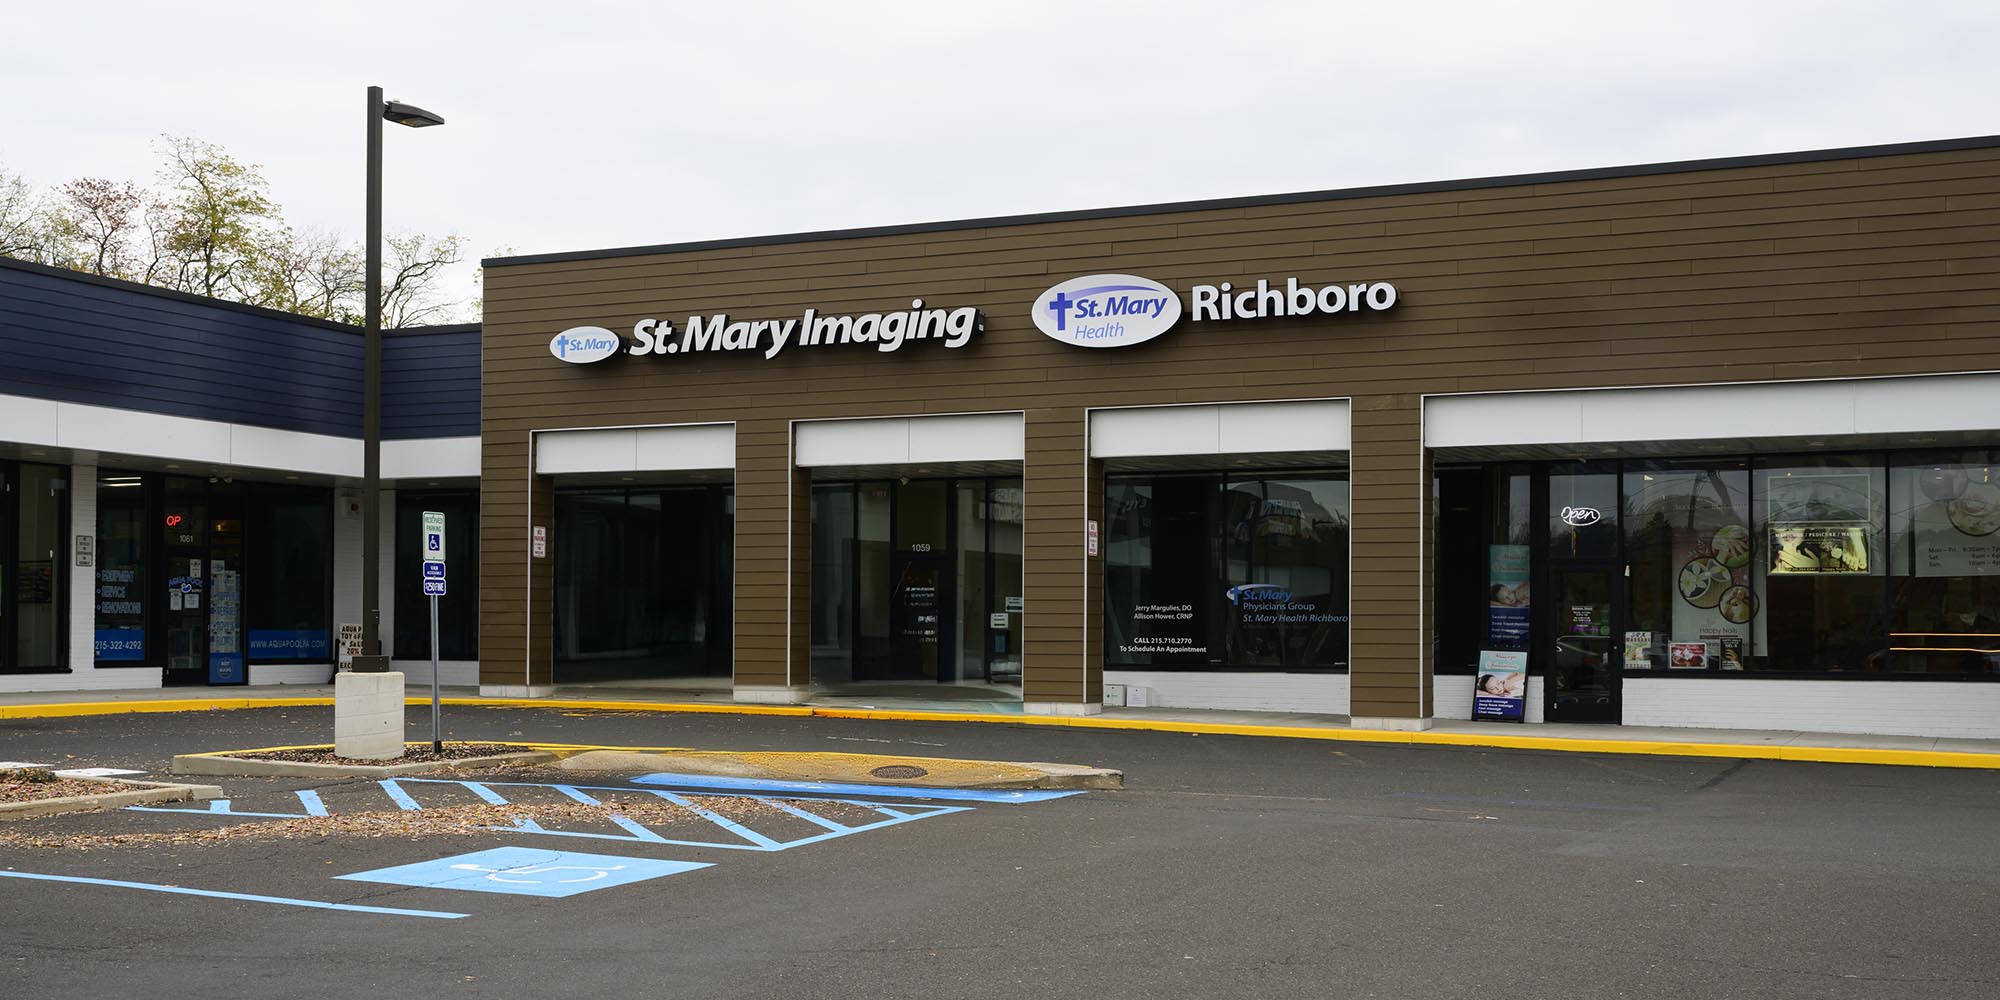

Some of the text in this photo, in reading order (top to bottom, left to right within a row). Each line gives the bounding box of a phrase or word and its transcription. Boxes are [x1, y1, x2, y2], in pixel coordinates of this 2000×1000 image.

[1191, 277, 1397, 321] Richboro
[799, 298, 979, 354] Imaging
[1074, 321, 1125, 341] Health
[1561, 506, 1597, 525] Open
[911, 543, 931, 553] 1059
[101, 585, 126, 598] SERVICE
[101, 601, 142, 614] RENOVATIONS
[1135, 605, 1150, 613] Jerry
[1151, 604, 1180, 612] Margulies,
[1243, 602, 1316, 612] Physicians Group
[1243, 613, 1349, 624] St. Mary Health Richboro
[95, 640, 142, 650] 215-322-4292
[1166, 646, 1207, 654] Appointment
